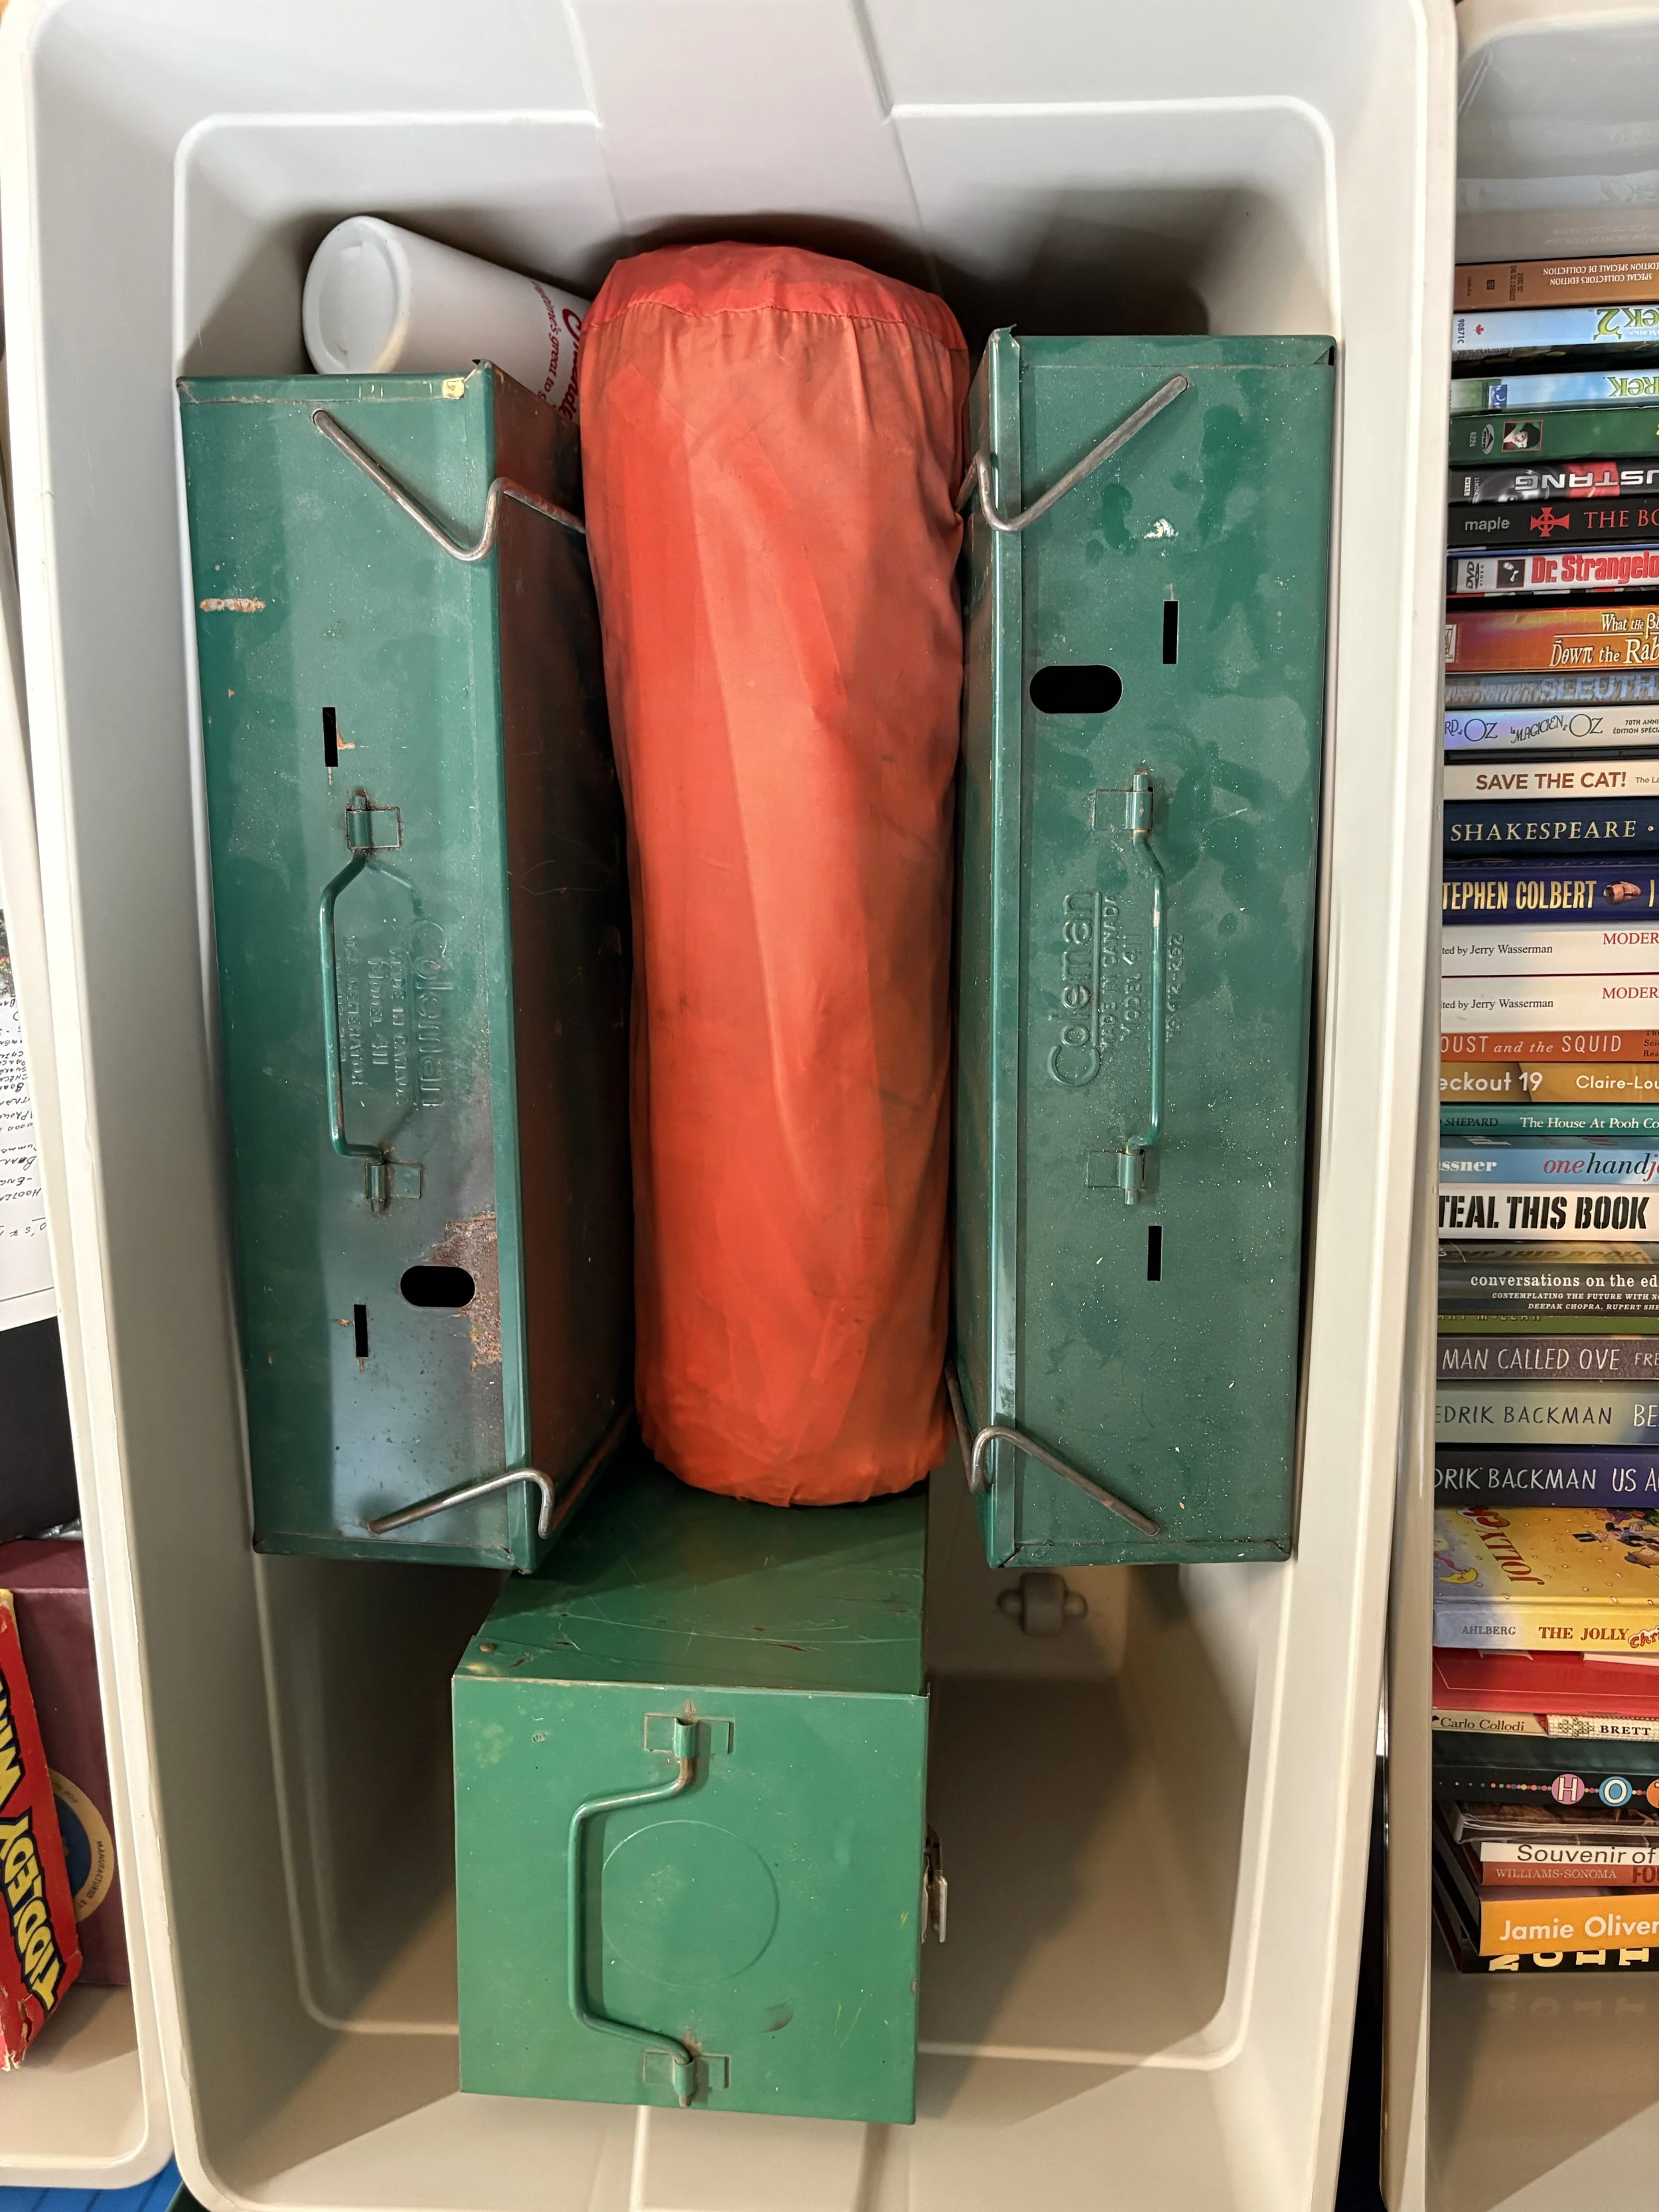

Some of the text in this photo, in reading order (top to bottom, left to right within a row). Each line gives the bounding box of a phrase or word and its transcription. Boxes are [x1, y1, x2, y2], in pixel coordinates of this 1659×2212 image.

[1543, 265, 1587, 275] COLLECTION
[1627, 273, 1652, 281] SPECIAL
[1550, 277, 1579, 285] EDITION
[548, 332, 560, 378] great
[543, 377, 555, 392] to
[1465, 516, 1510, 532] maple
[1583, 510, 1629, 529] THE
[1466, 561, 1475, 589] DVD
[1531, 556, 1557, 583] Dr.
[1601, 613, 1628, 632] What
[1599, 646, 1621, 662] the
[1613, 725, 1638, 735] ÉDITION
[1476, 773, 1528, 790] SAVE
[1534, 773, 1575, 789] THE
[1580, 771, 1627, 788] CAT!
[1451, 820, 1636, 842] SHAKESPEARE
[1515, 880, 1597, 910] COLBERT
[1102, 891, 1119, 968] CANADA
[1603, 932, 1659, 945] MODER
[1457, 944, 1467, 956] by
[1470, 944, 1494, 956] Jerry
[1497, 944, 1553, 954] Wasserman
[1047, 892, 1102, 1088] Coleman
[1602, 988, 1659, 999] MODER
[402, 920, 454, 1107] Coleman
[1119, 972, 1142, 1043] MODEL
[1458, 1001, 1469, 1011] by
[1471, 999, 1495, 1011] Jerry
[1498, 998, 1553, 1009] Wasserman
[1494, 1041, 1523, 1053] and
[1530, 1041, 1553, 1053] the
[1561, 1035, 1622, 1054] SQUID
[1518, 1072, 1543, 1091] 19
[1445, 1118, 1498, 1127] SHEPARD
[1520, 1116, 1543, 1128] The
[1548, 1116, 1586, 1128] House
[1589, 1117, 1605, 1128] At
[1609, 1117, 1639, 1129] Pooh
[1506, 1195, 1567, 1229] THIS
[1575, 1195, 1650, 1230] BOOK
[1471, 1274, 1658, 1288] conversations on the ed
[1442, 1348, 1489, 1370] MAN
[1498, 1348, 1569, 1370] CALLED
[1579, 1349, 1621, 1370] OVE
[1504, 1406, 1612, 1424] BACKMAN
[1488, 1468, 1596, 1490] BACKMAN
[1611, 1468, 1636, 1492] US
[1475, 1529, 1545, 1585] JOLLY
[1461, 1626, 1516, 1636] AHLBERG
[1539, 1626, 1573, 1640] THE
[1580, 1627, 1630, 1641] JOLLY
[1440, 1716, 1525, 1732] Carlo Collodi
[1600, 1725, 1652, 1736] BRETT
[1517, 1844, 1656, 1864] Souvenir of
[1496, 1868, 1617, 1879] WILLIAMS-SONOMA
[1499, 1913, 1659, 1941] Jamie Oliver
